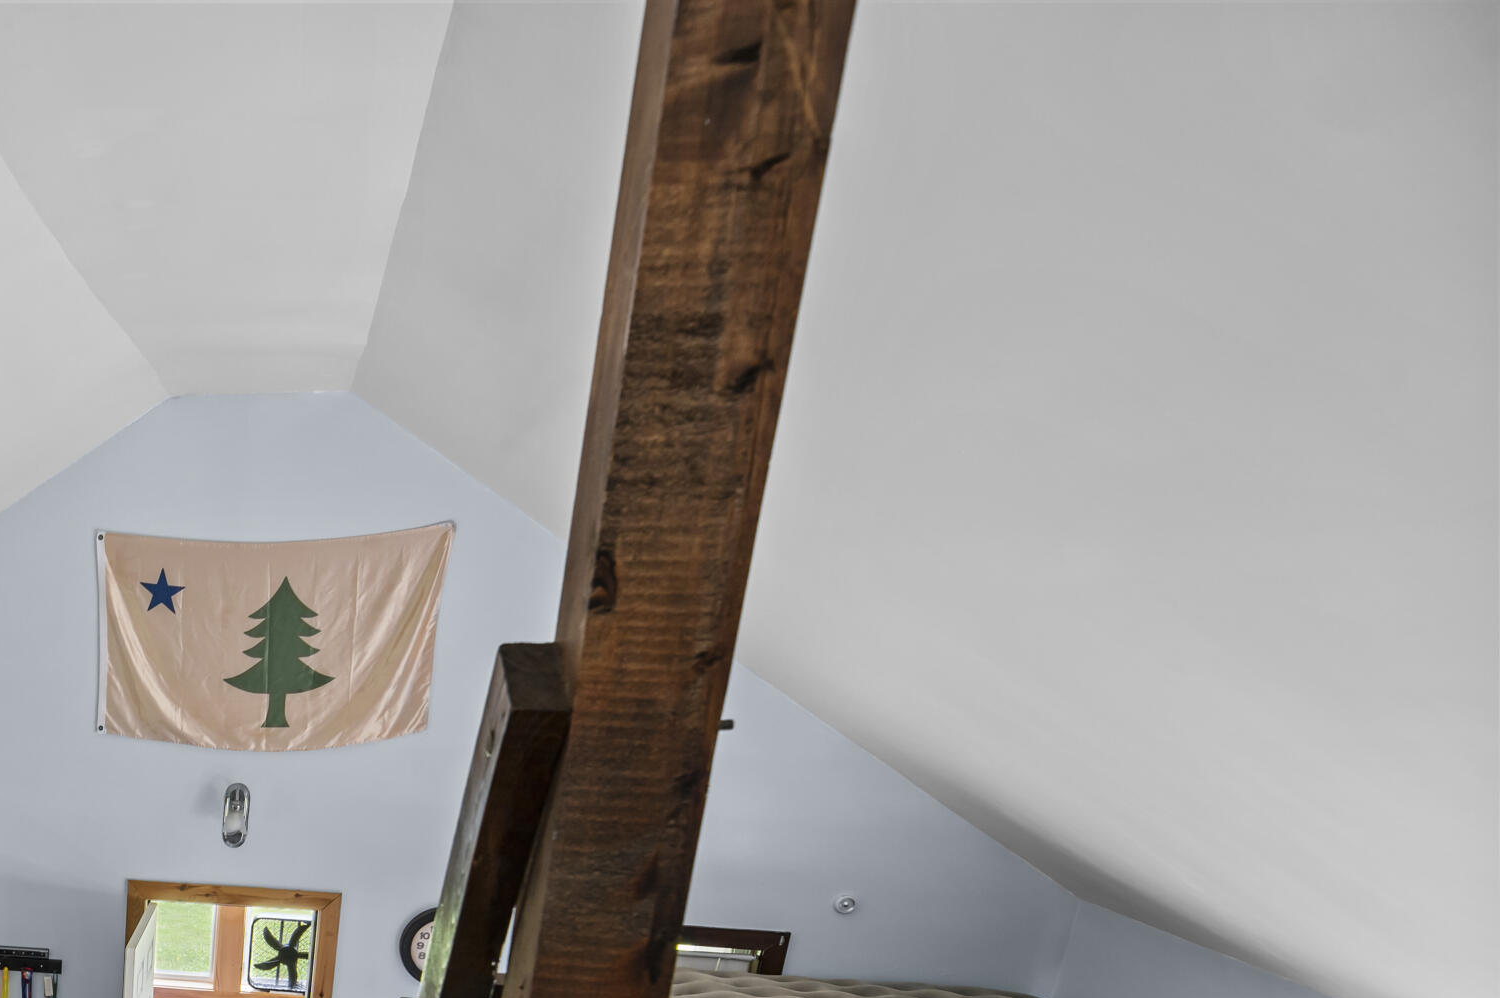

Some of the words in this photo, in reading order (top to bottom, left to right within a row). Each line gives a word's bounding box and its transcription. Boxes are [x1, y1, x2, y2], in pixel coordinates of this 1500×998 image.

[420, 932, 431, 940] 10
[416, 942, 425, 950] 9
[418, 952, 426, 960] 8
